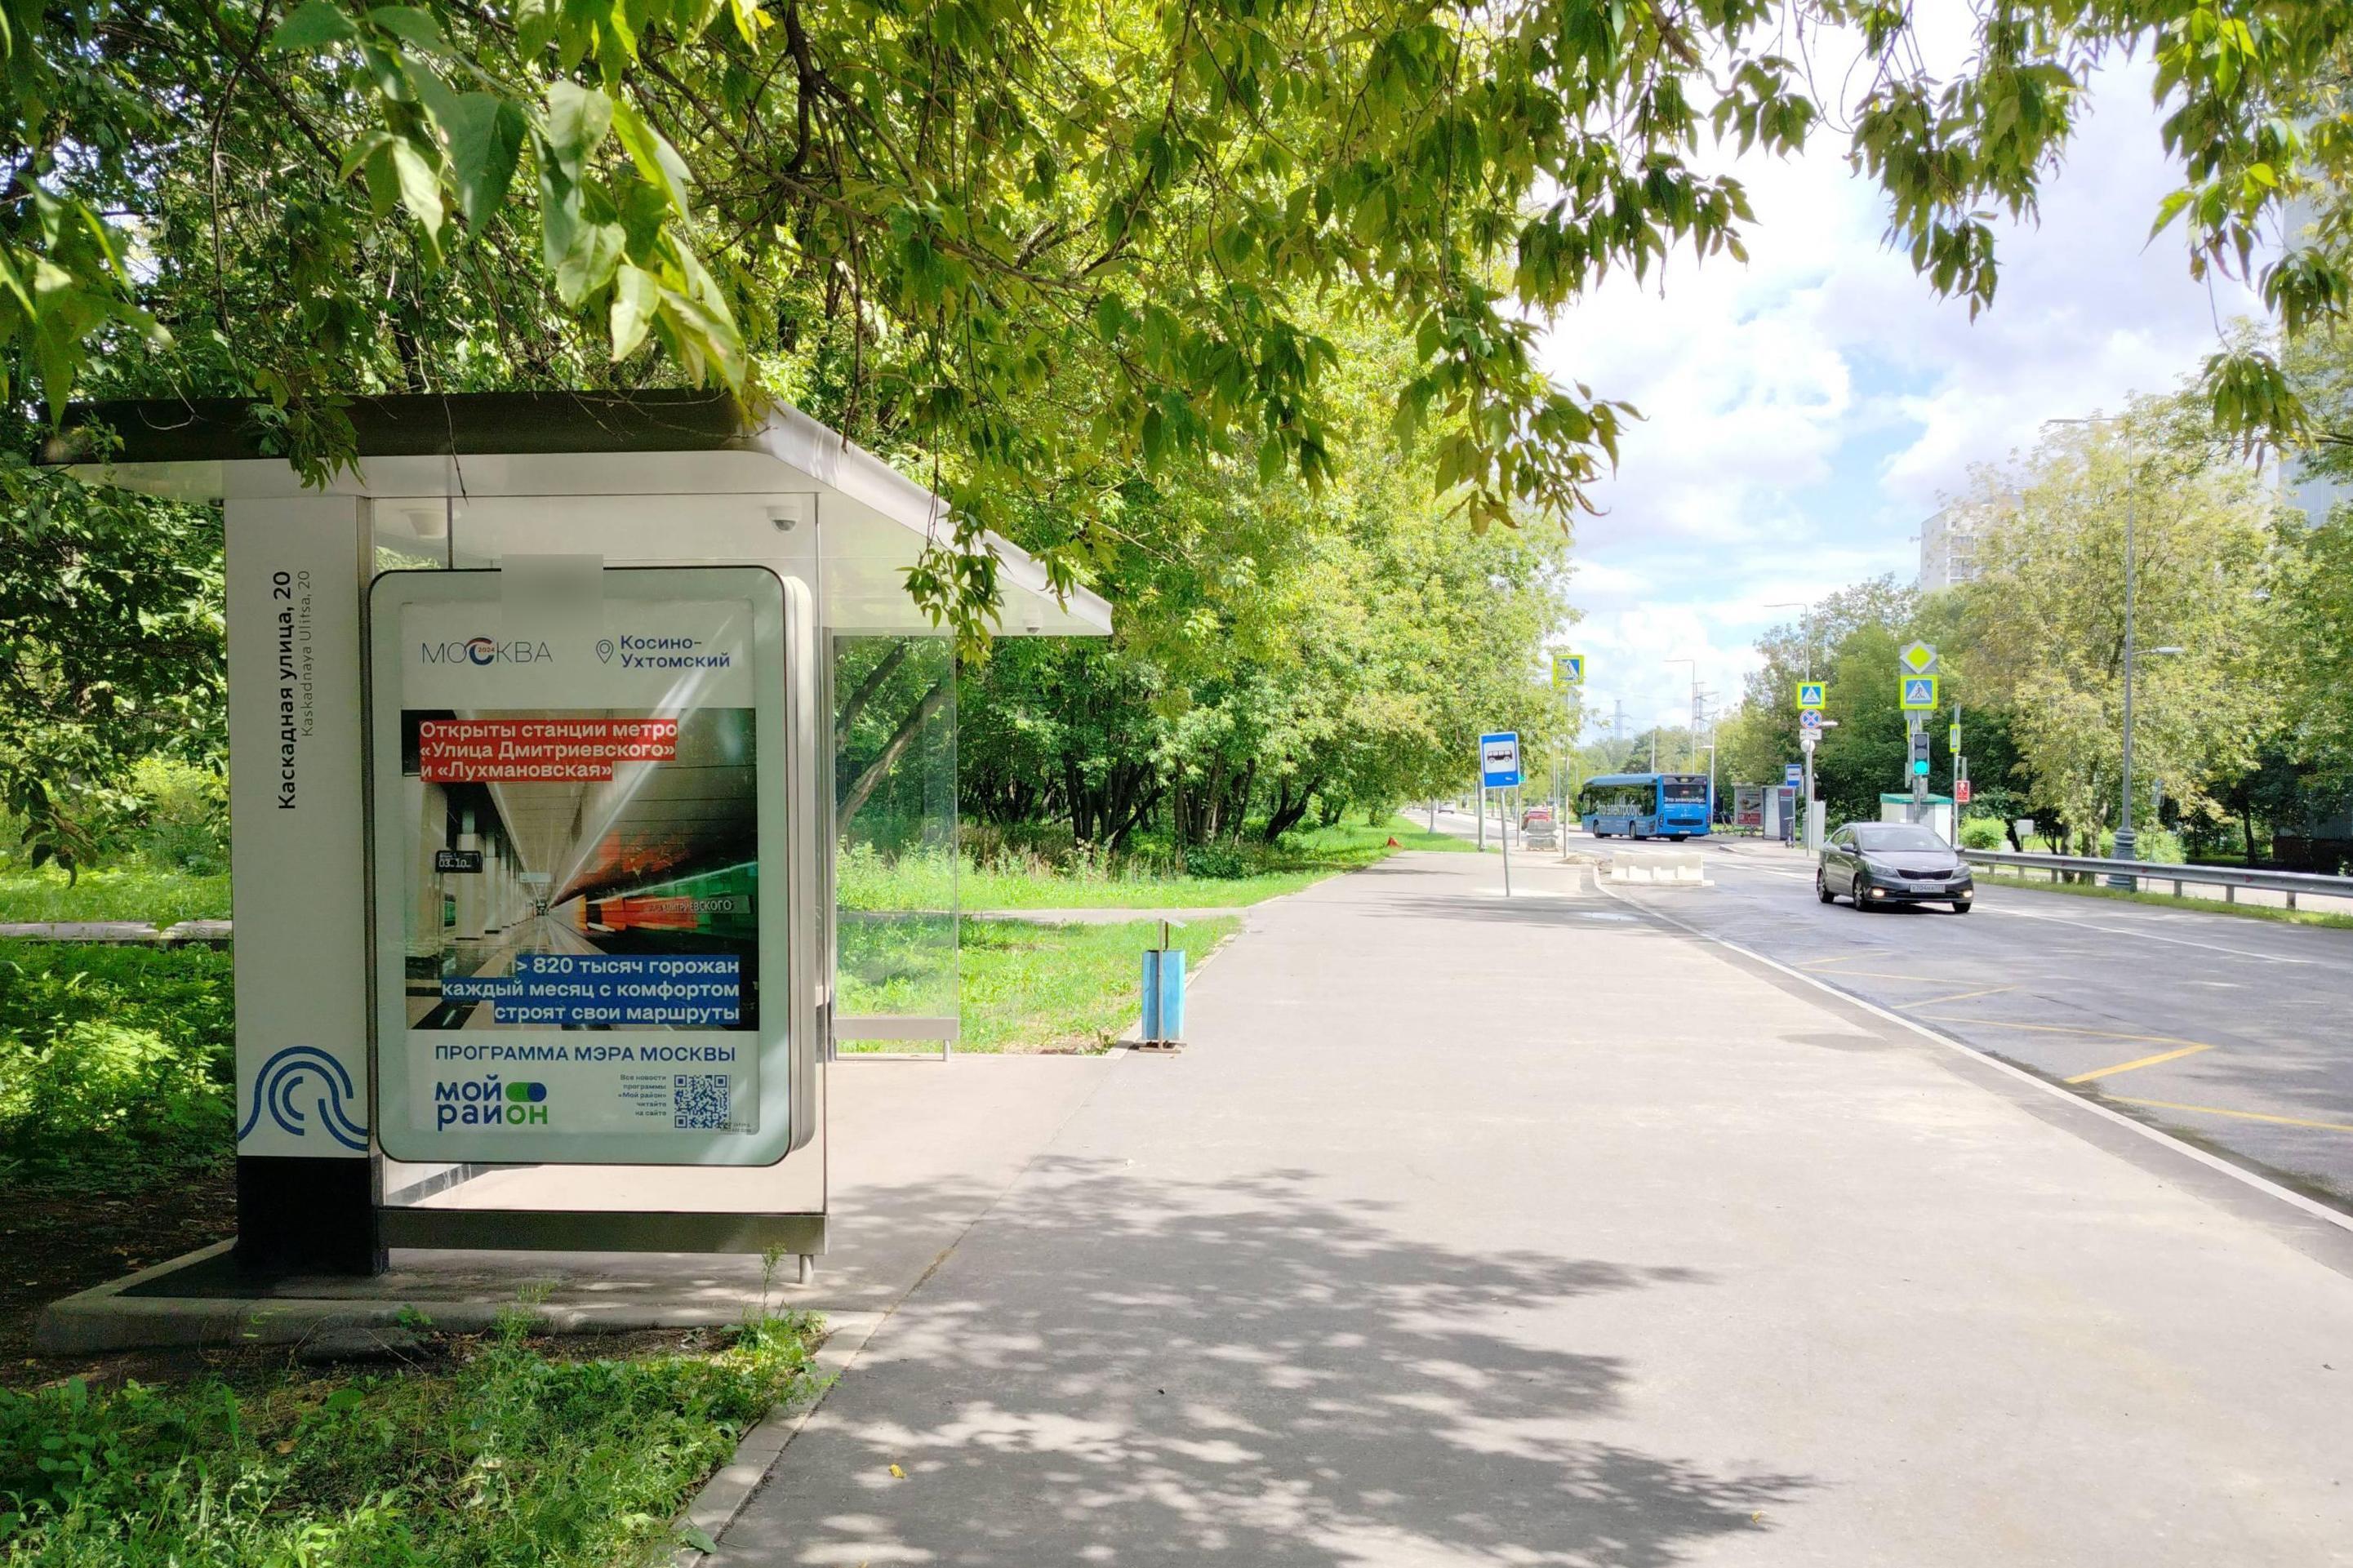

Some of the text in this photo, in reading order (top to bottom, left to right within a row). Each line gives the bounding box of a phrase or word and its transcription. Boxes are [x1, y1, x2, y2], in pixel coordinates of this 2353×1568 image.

[421, 637, 554, 666] МОСКВА
[620, 635, 702, 650] Косино-
[298, 571, 314, 736] Kaskadnaya Ulitsa, 20
[621, 651, 731, 669] Ухтомский
[274, 571, 297, 809] Каскадная улица, 20
[420, 722, 678, 740] Открыты станции метро
[420, 741, 675, 759] «Улица Дмитриевского»
[420, 762, 612, 781] и «Лухмановская»
[1596, 800, 1607, 815] Это
[532, 957, 573, 975] 820
[578, 959, 643, 974] тысяч
[649, 959, 739, 977] горожан
[442, 979, 739, 1001] каждый месяц с комфортом
[494, 1006, 739, 1024] строят свои маршруты
[435, 1046, 736, 1061] ПРОГРАММА МЭРА МОСКВЫ
[434, 1074, 502, 1102] мой
